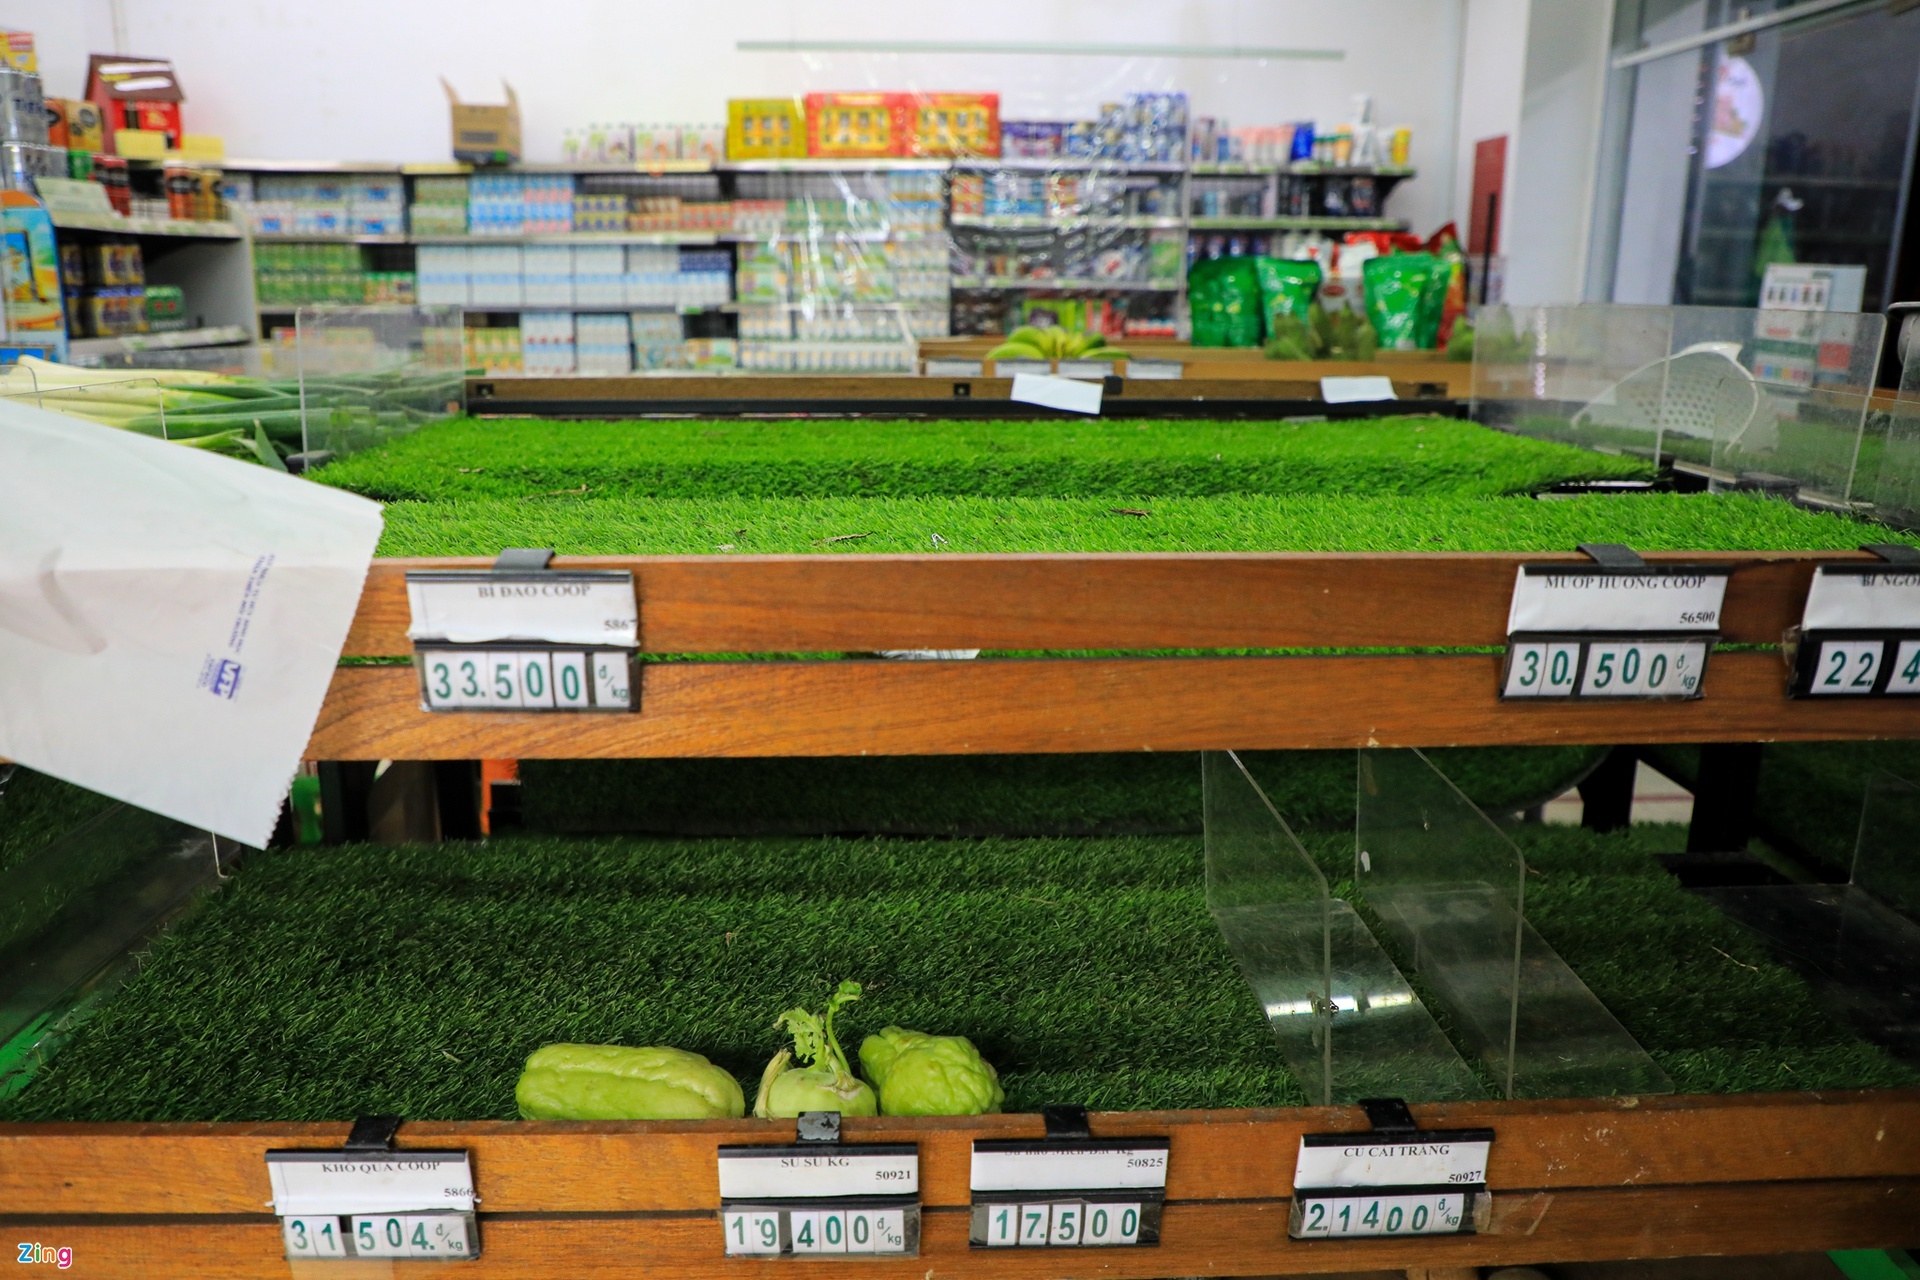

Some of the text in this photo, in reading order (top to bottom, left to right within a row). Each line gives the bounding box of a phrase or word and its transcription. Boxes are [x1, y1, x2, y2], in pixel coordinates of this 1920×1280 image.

[1545, 576, 1706, 589] MUOP HUONG COOP
[541, 584, 590, 597] COOP
[1679, 611, 1715, 624] 56500
[433, 661, 580, 700] 33.500
[1344, 1145, 1450, 1157] CU CAI TRANG
[360, 1163, 393, 1174] QUA
[397, 1161, 440, 1172] COOP
[781, 1157, 849, 1168] SU SU KG
[1127, 1158, 1163, 1168] 50825
[875, 1170, 911, 1180] 50921
[1448, 1170, 1481, 1183] 50927
[996, 1209, 1137, 1241] 17.500
